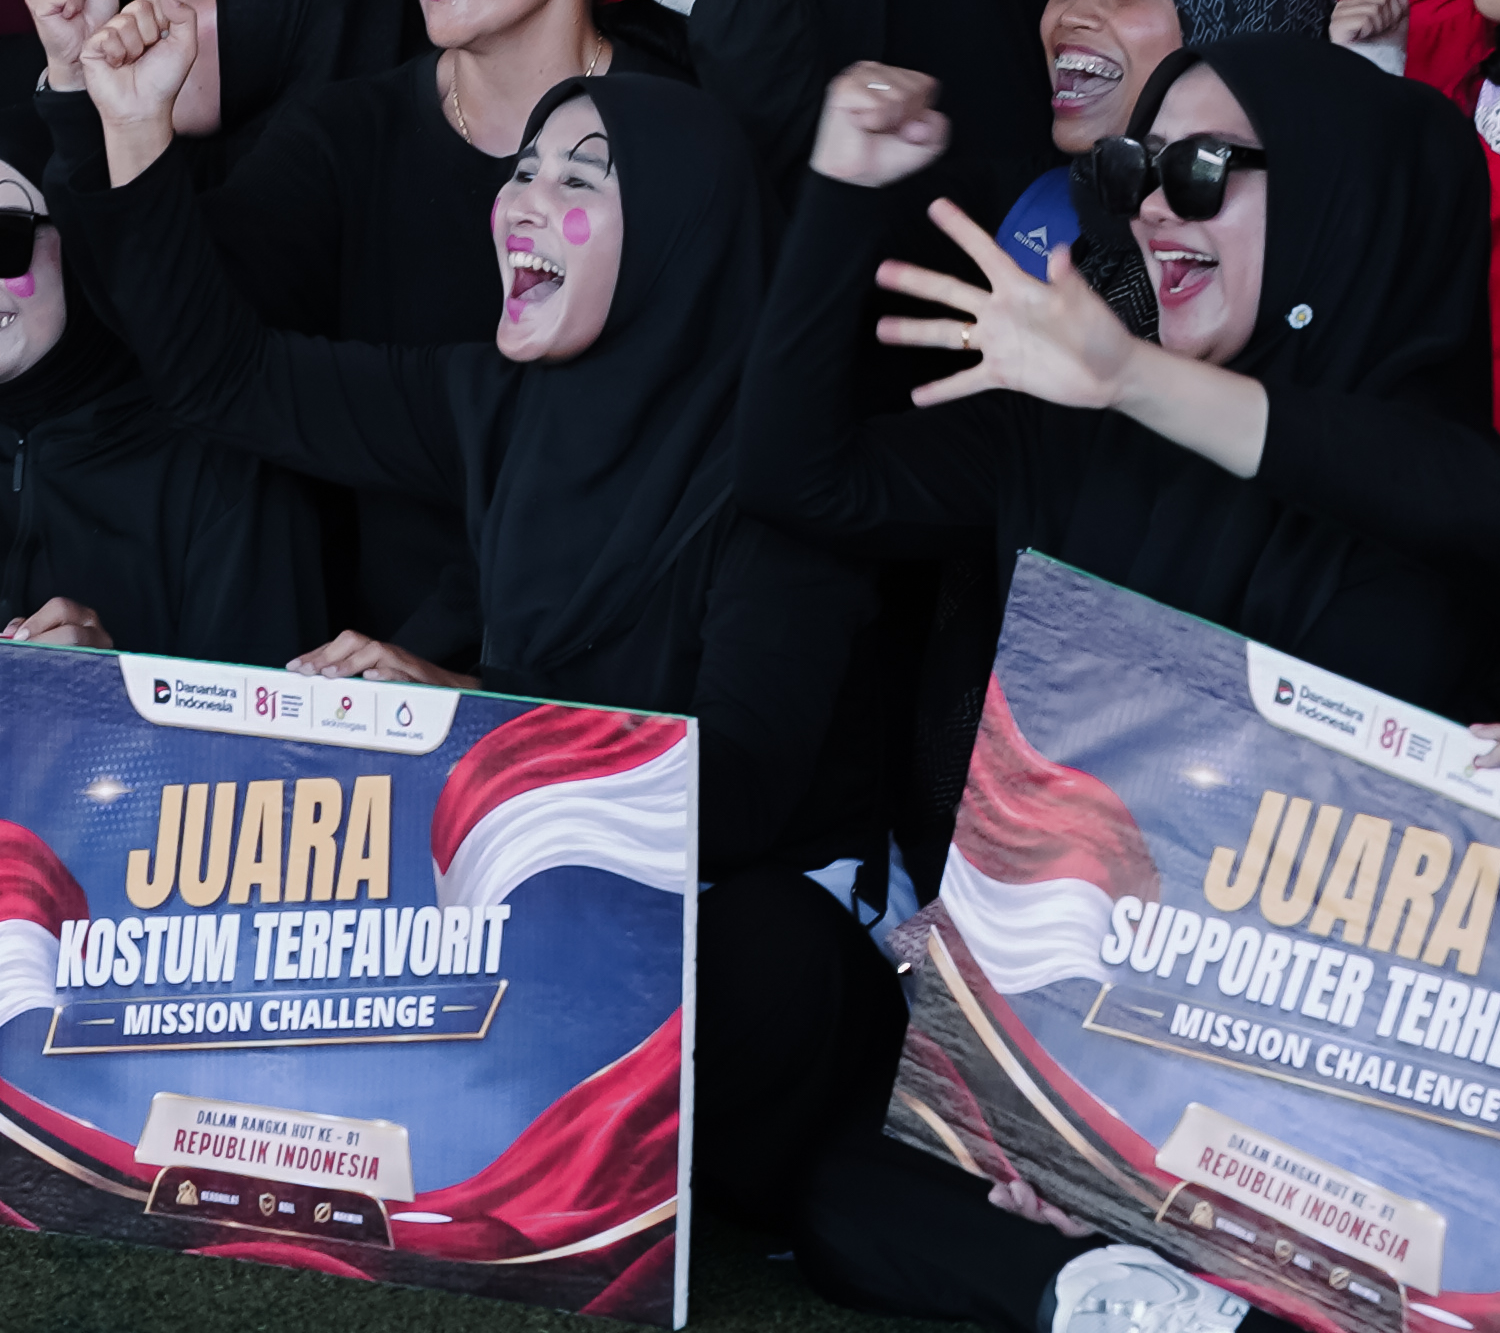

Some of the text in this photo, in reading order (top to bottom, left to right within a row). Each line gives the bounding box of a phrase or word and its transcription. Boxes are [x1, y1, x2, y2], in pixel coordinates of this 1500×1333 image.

[174, 695, 233, 713] Indonesia
[175, 679, 237, 699] Danantara
[255, 686, 279, 722] 81
[1300, 685, 1365, 723] Danantara
[126, 774, 392, 909] JUARA
[56, 904, 511, 989] KOSTUM TERFAVORIT
[1099, 895, 1378, 1031] SUPPORTER
[122, 995, 436, 1036] MISSION CHALLENGE
[1168, 1001, 1311, 1071] MISSION
[196, 1110, 237, 1129] DALAM
[240, 1115, 288, 1136] RANGKA
[291, 1122, 315, 1140] HUT
[316, 1127, 334, 1143] KE
[173, 1129, 380, 1181] REPUBLIK INDONESIA
[1197, 1146, 1301, 1211] REPUBLIK
[1300, 1195, 1411, 1263] INDONESIA
